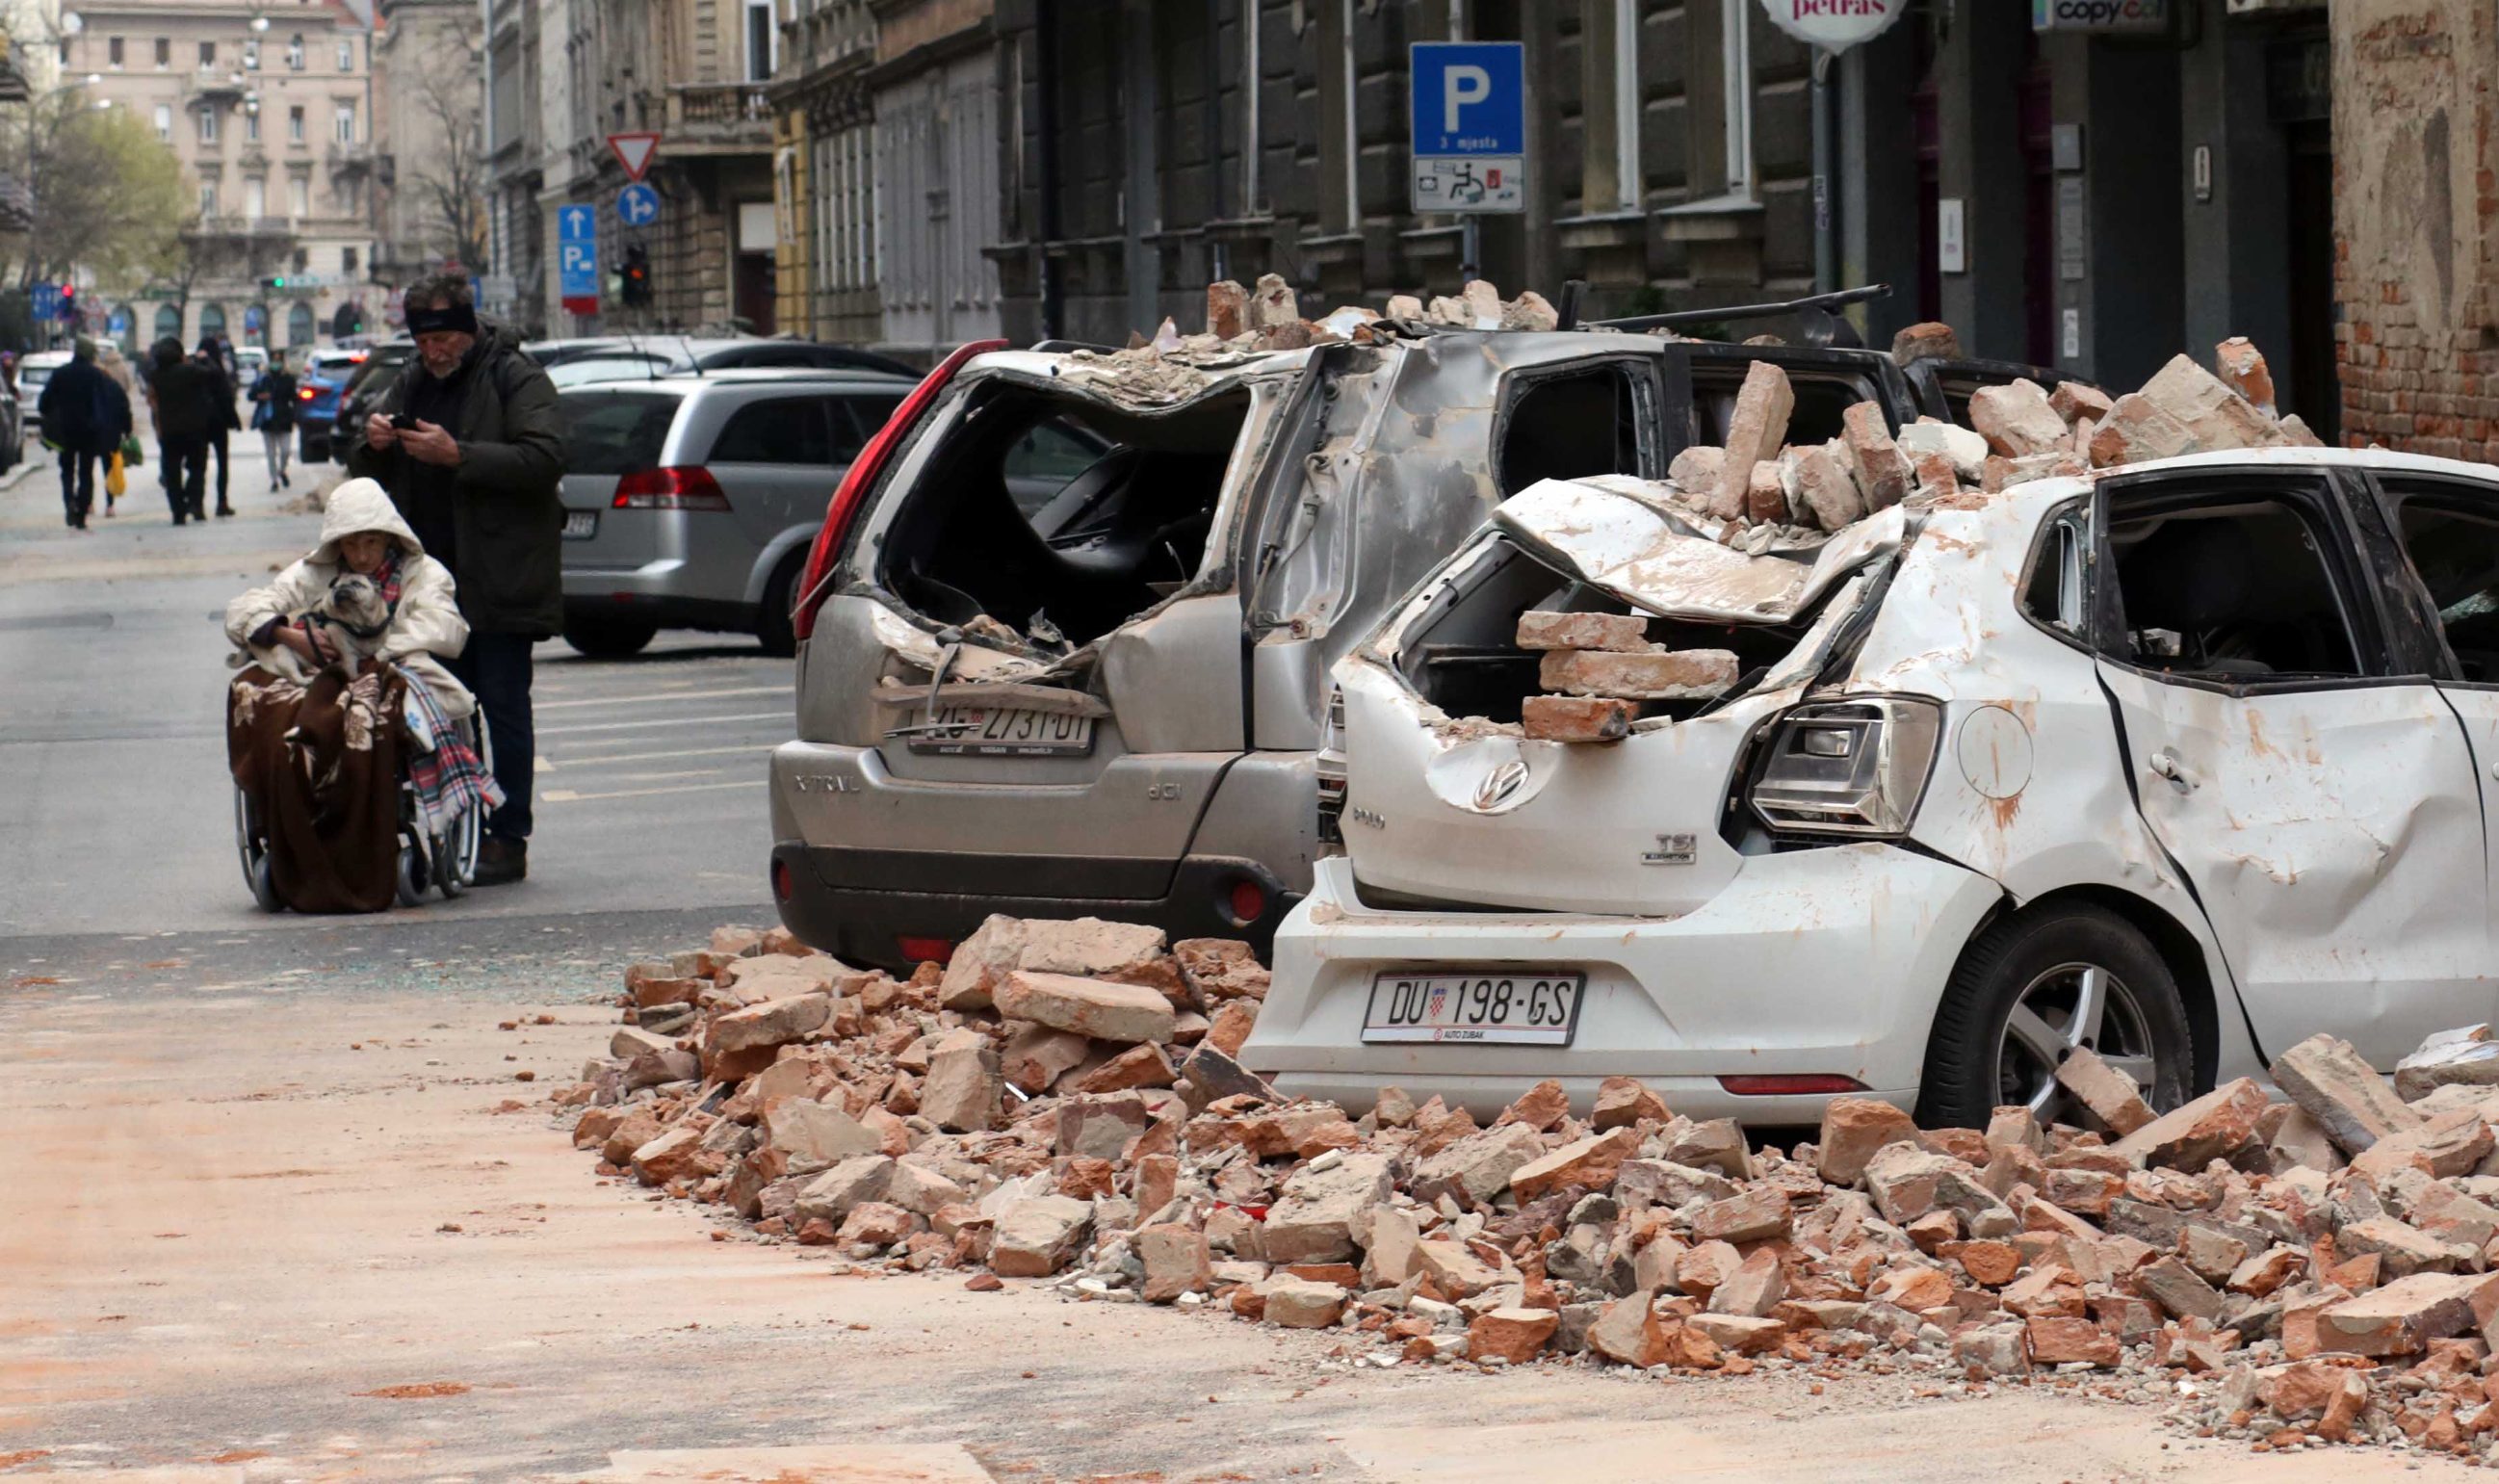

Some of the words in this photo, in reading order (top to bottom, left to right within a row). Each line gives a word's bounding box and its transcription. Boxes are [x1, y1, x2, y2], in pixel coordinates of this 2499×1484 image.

[1792, 0, 1886, 20] petras
[1445, 65, 1491, 133] P
[1440, 137, 1449, 149] 3
[1457, 138, 1499, 153] mjesta
[564, 246, 583, 272] P
[1389, 980, 1431, 1025] DU
[1453, 979, 1572, 1026] 198-GS
[1444, 1030, 1462, 1039] AUTO
